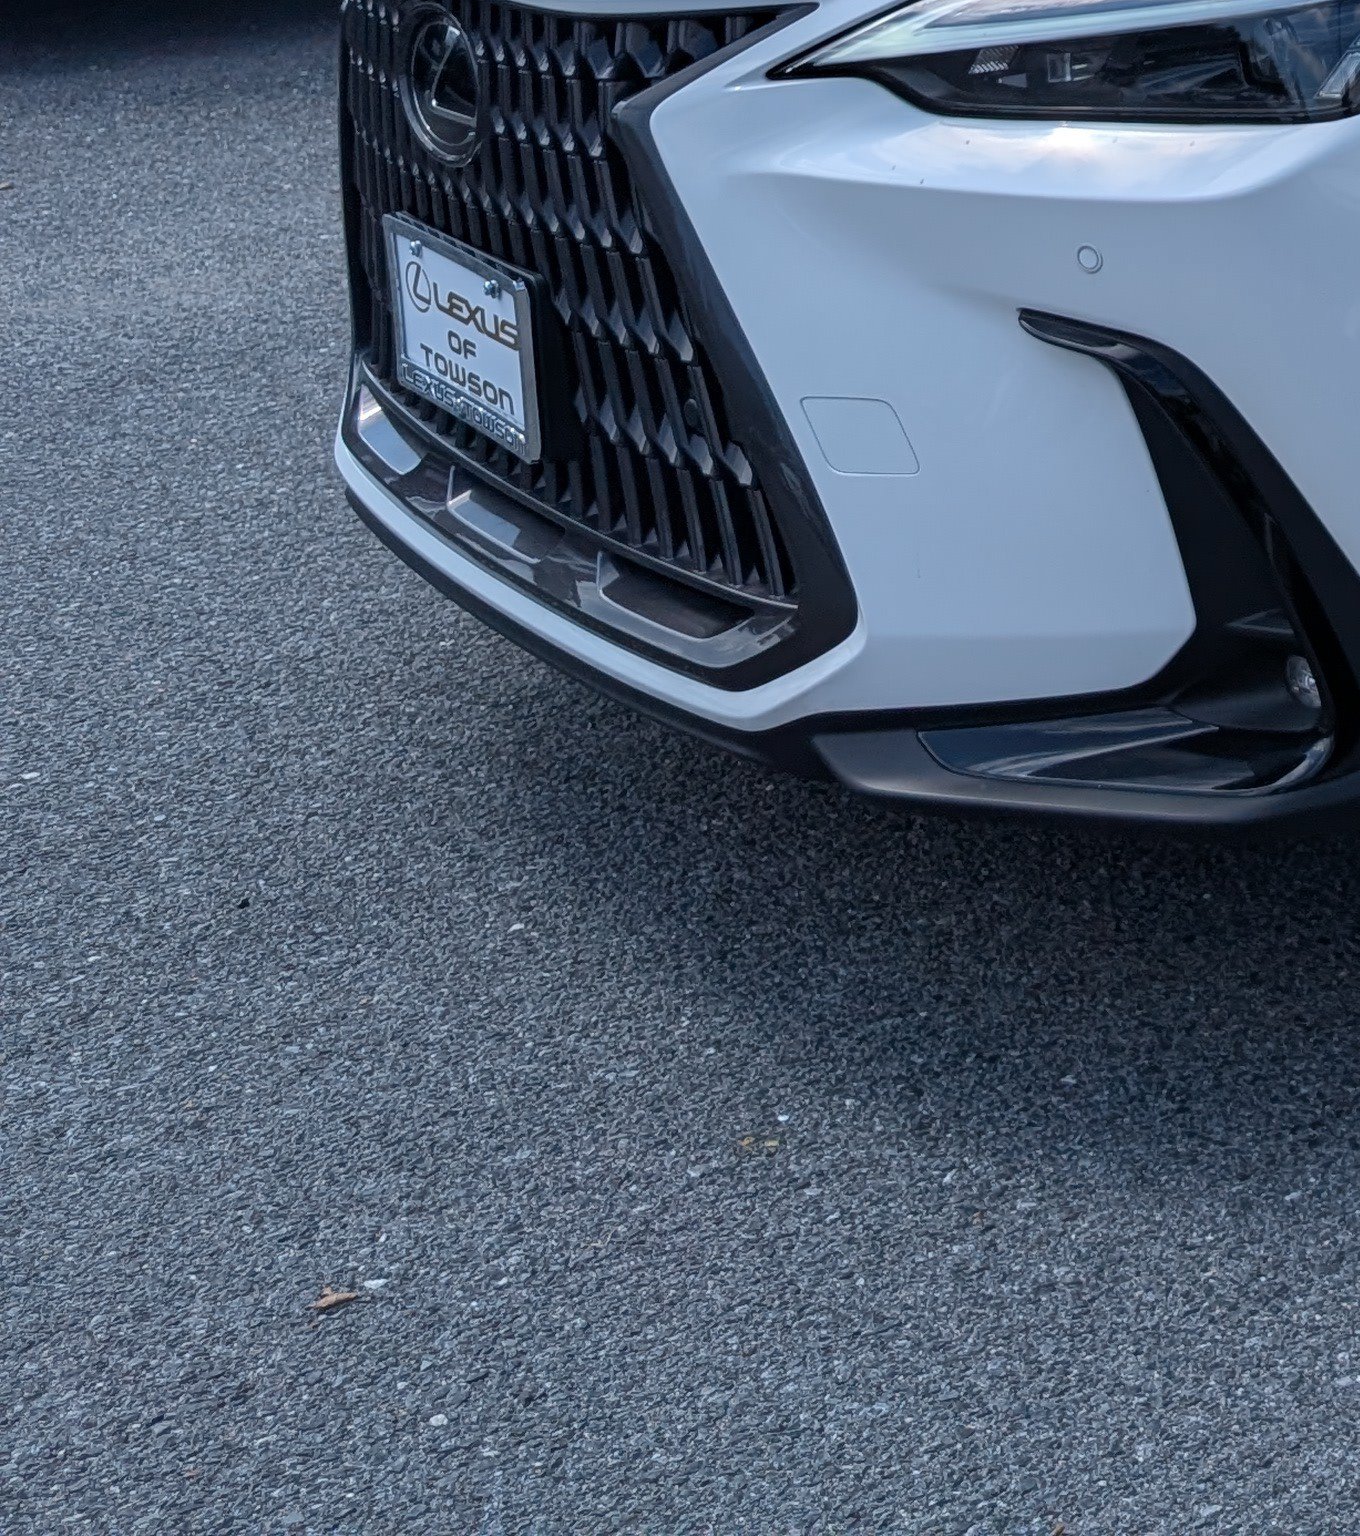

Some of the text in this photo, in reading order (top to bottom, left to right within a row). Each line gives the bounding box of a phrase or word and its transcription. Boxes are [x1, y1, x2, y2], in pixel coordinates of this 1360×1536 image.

[432, 281, 521, 351] LEXUS
[447, 329, 477, 360] OF
[402, 363, 456, 407] LEXUS
[420, 342, 515, 416] TOWSON
